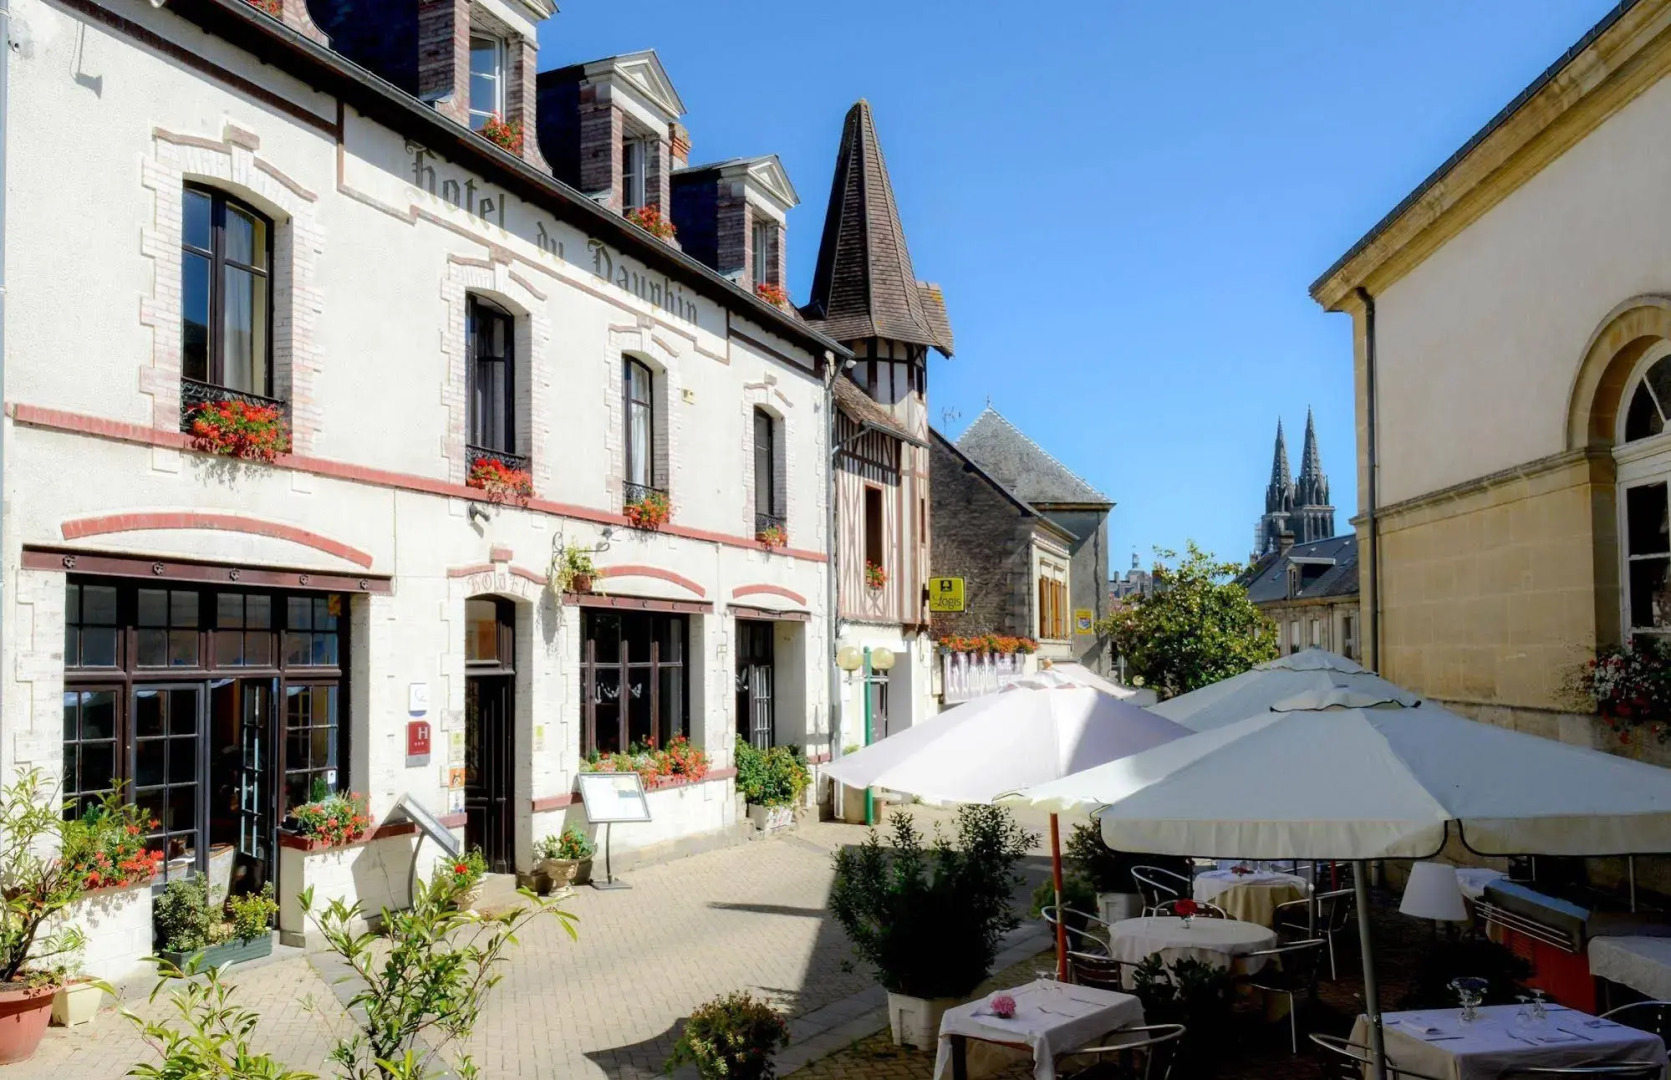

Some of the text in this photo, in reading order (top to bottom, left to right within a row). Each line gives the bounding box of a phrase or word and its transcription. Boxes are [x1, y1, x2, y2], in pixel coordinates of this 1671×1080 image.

[537, 221, 565, 266] du
[587, 238, 699, 328] Dauphin
[931, 590, 961, 609] Logis
[418, 726, 428, 739] H
